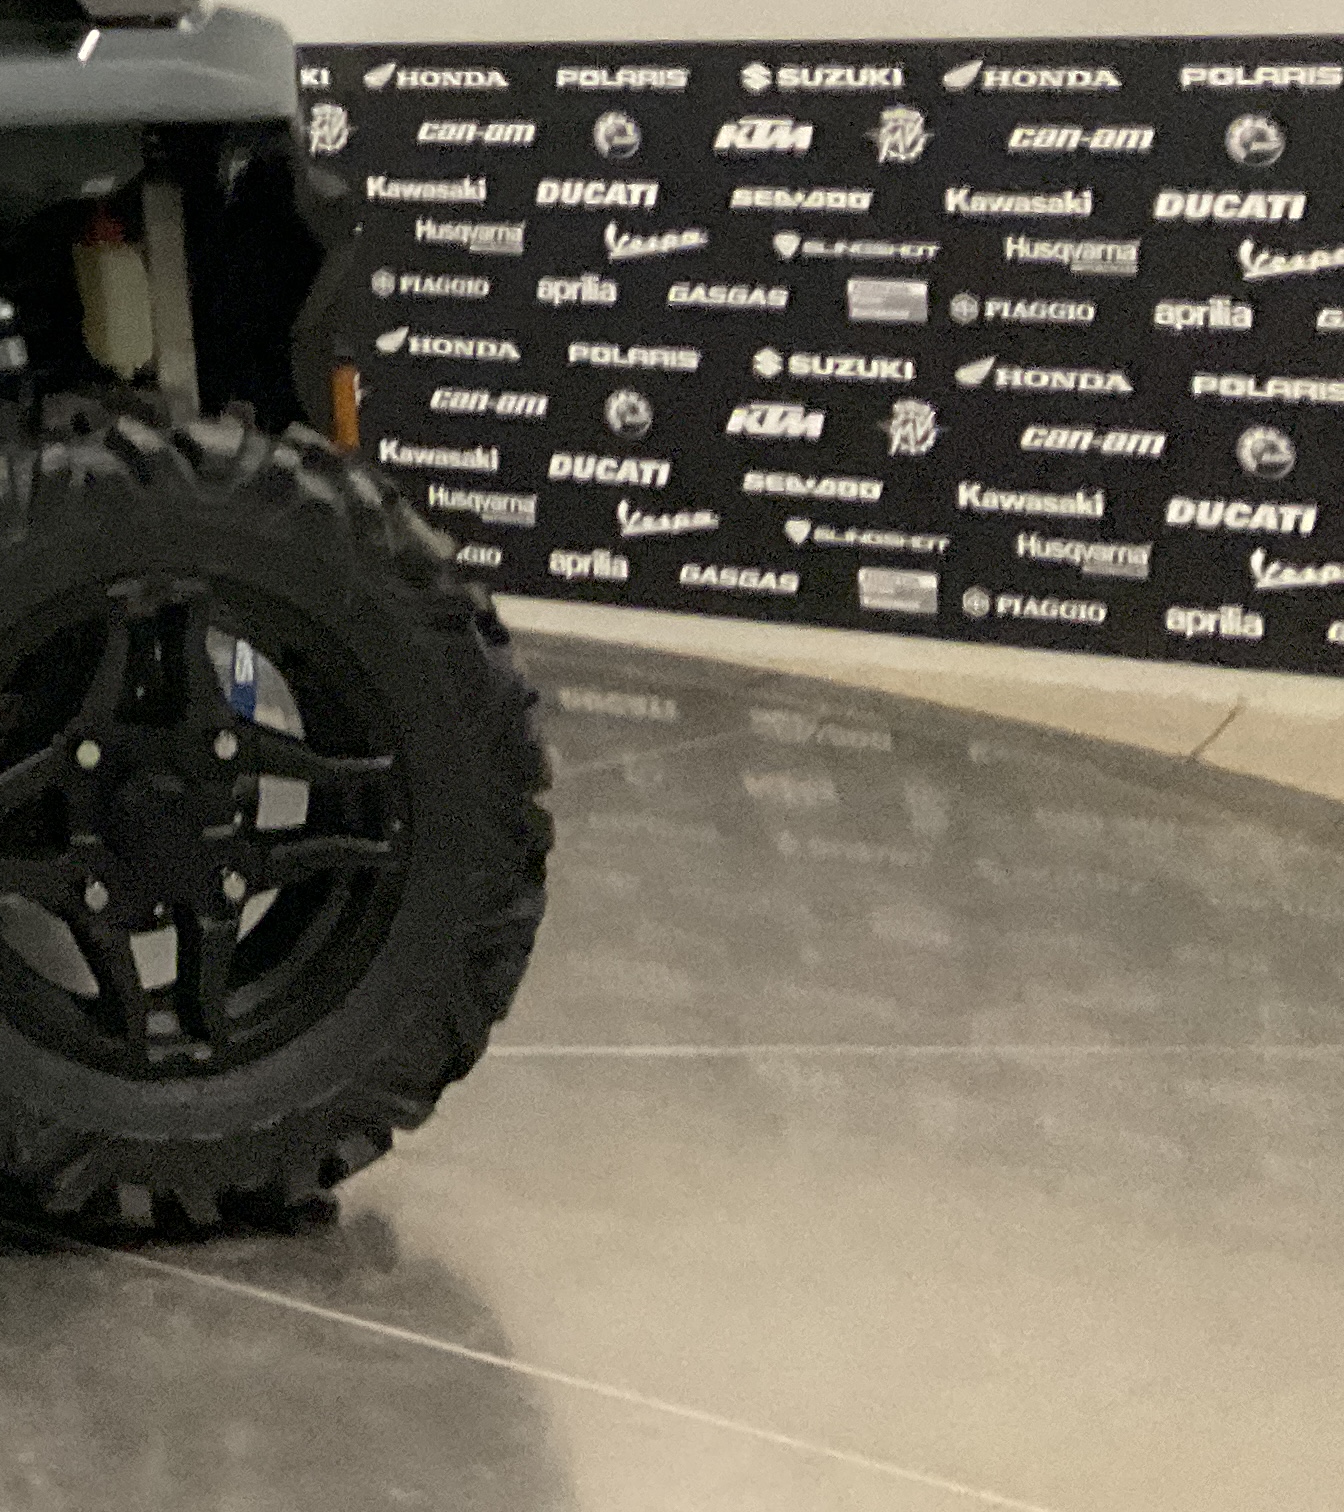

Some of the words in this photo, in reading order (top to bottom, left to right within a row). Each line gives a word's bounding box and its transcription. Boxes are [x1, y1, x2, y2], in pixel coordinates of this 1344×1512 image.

[396, 68, 509, 89] HONDA
[556, 67, 690, 89] POLARIS
[775, 65, 904, 90] SUZUKI
[983, 67, 1122, 90] HONDA
[1180, 64, 1344, 89] POLARIS
[417, 121, 536, 144] can-am
[714, 116, 813, 151] KTM
[1008, 125, 1155, 151] can-am
[366, 176, 486, 201] Kawasaki
[536, 179, 658, 208] DUCATI
[945, 186, 1092, 216] Kawasaki
[1154, 190, 1306, 222] DUCATI
[399, 275, 489, 296] PIAGGIO
[537, 274, 617, 306] aprilia
[668, 283, 788, 308] GASGAS
[983, 298, 1095, 323] PIAGGIO
[1154, 296, 1253, 331] aprilia
[409, 336, 520, 360] HONDA
[568, 343, 701, 370] POLARIS
[787, 353, 915, 381] SUZUKI
[996, 367, 1133, 393] HONDA
[430, 388, 548, 416] can-am
[1192, 373, 1344, 403] POLARIS
[726, 403, 824, 439] KTM
[380, 439, 498, 471] Kawasaki
[1021, 426, 1166, 457] can-am
[549, 453, 670, 486] DUCATI
[958, 482, 1104, 518] Kawasaki
[1166, 497, 1317, 534] DUCATI
[550, 550, 628, 580] aprilia
[680, 564, 799, 593] GASGAS
[1250, 548, 1344, 589] Vesp
[995, 595, 1107, 623] PIAGGIO
[1166, 605, 1264, 639] aprilia
